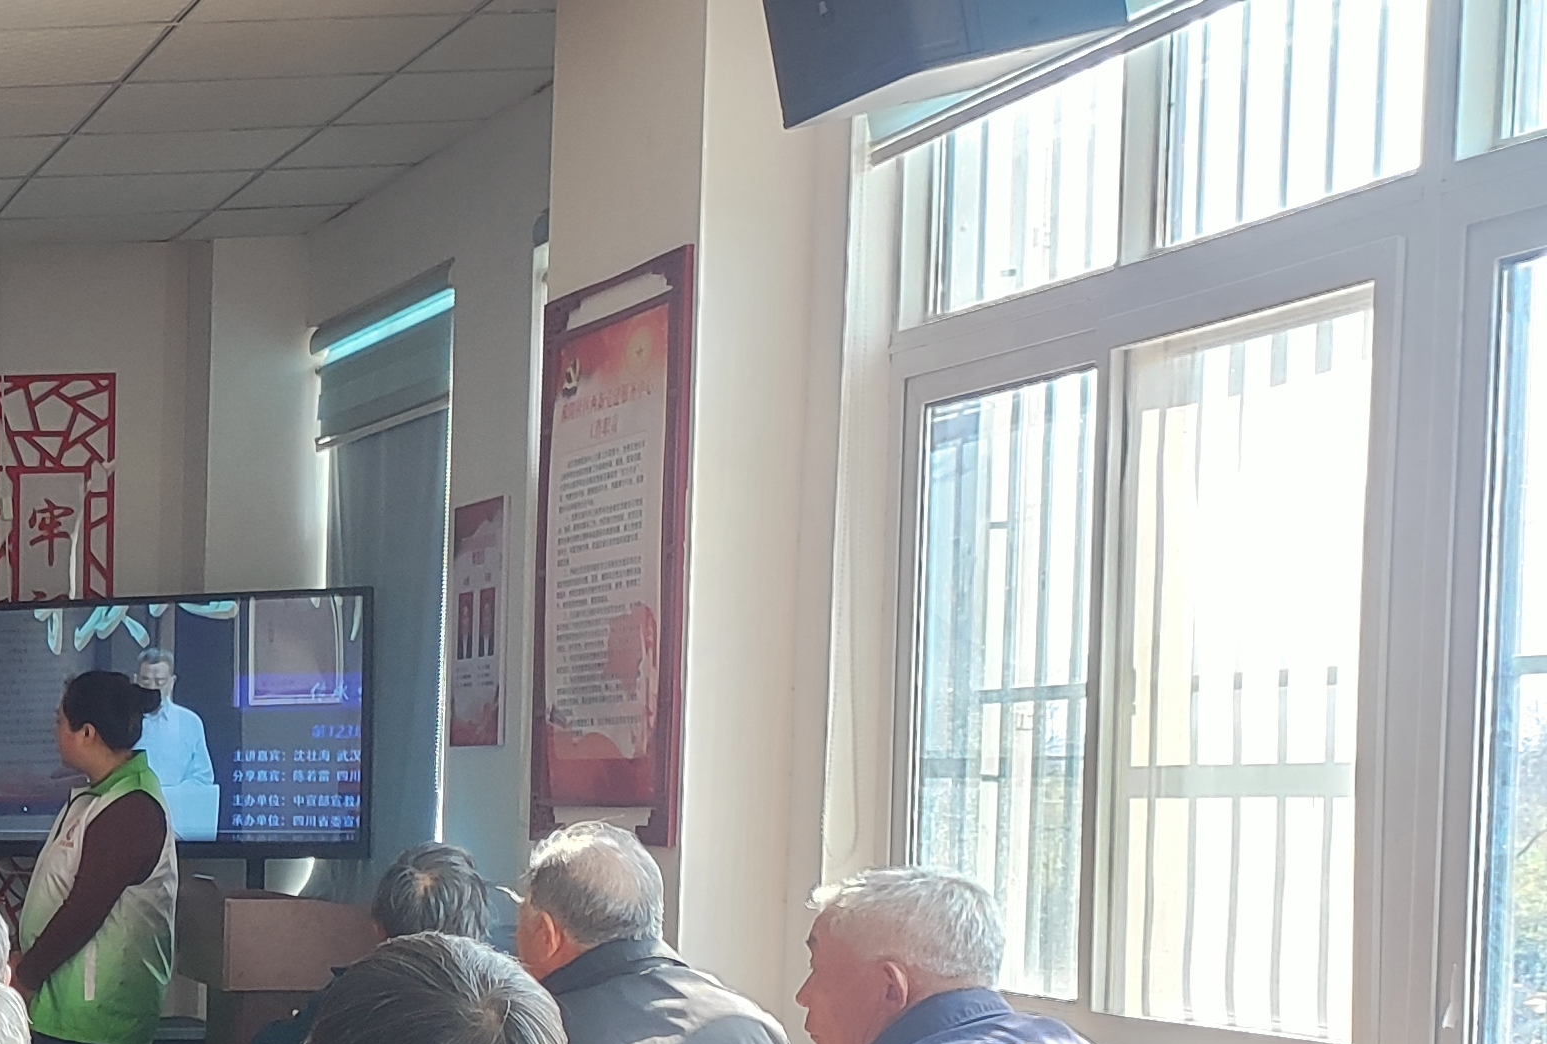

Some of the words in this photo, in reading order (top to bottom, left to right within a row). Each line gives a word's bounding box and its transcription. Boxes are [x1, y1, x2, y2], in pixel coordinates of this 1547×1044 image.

[292, 793, 361, 808] 中宣部宣教
